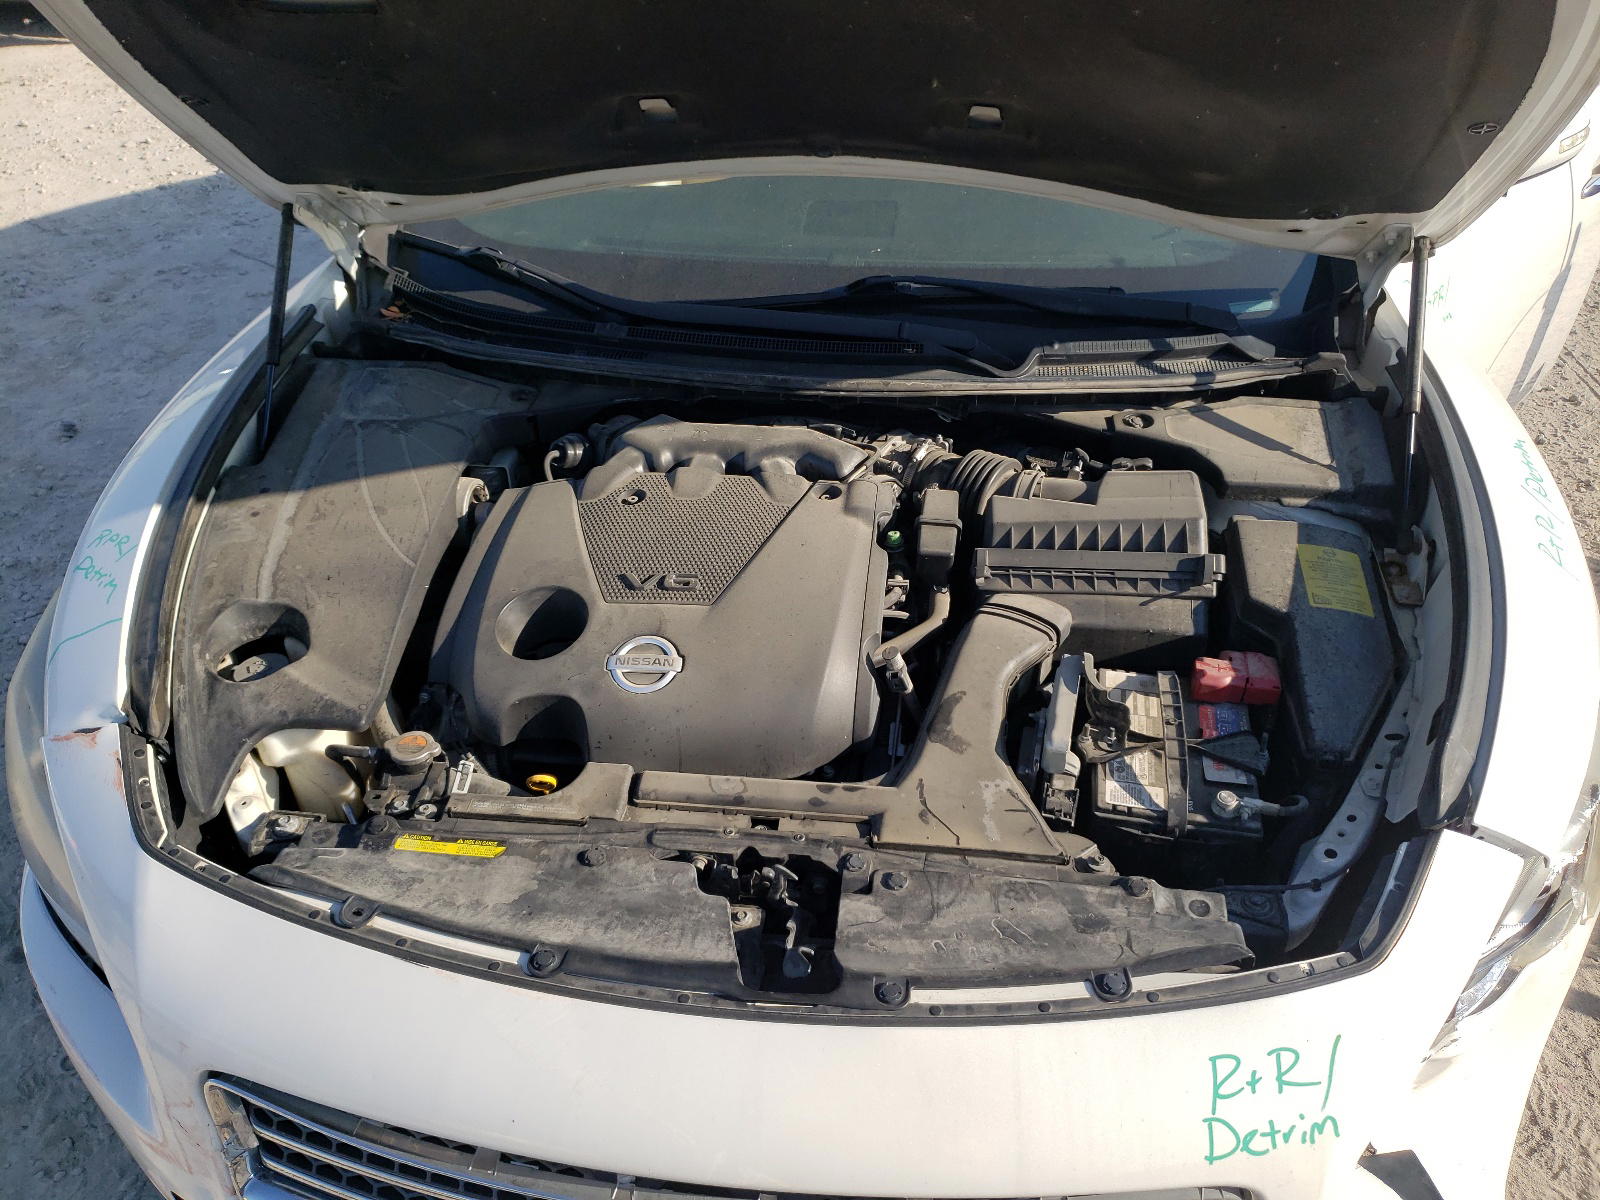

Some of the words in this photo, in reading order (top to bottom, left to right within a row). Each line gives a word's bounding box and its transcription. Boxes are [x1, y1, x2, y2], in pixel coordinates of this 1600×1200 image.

[618, 572, 700, 592] V6
[614, 657, 674, 667] NISSAN
[1202, 1113, 1340, 1165] Detrim
